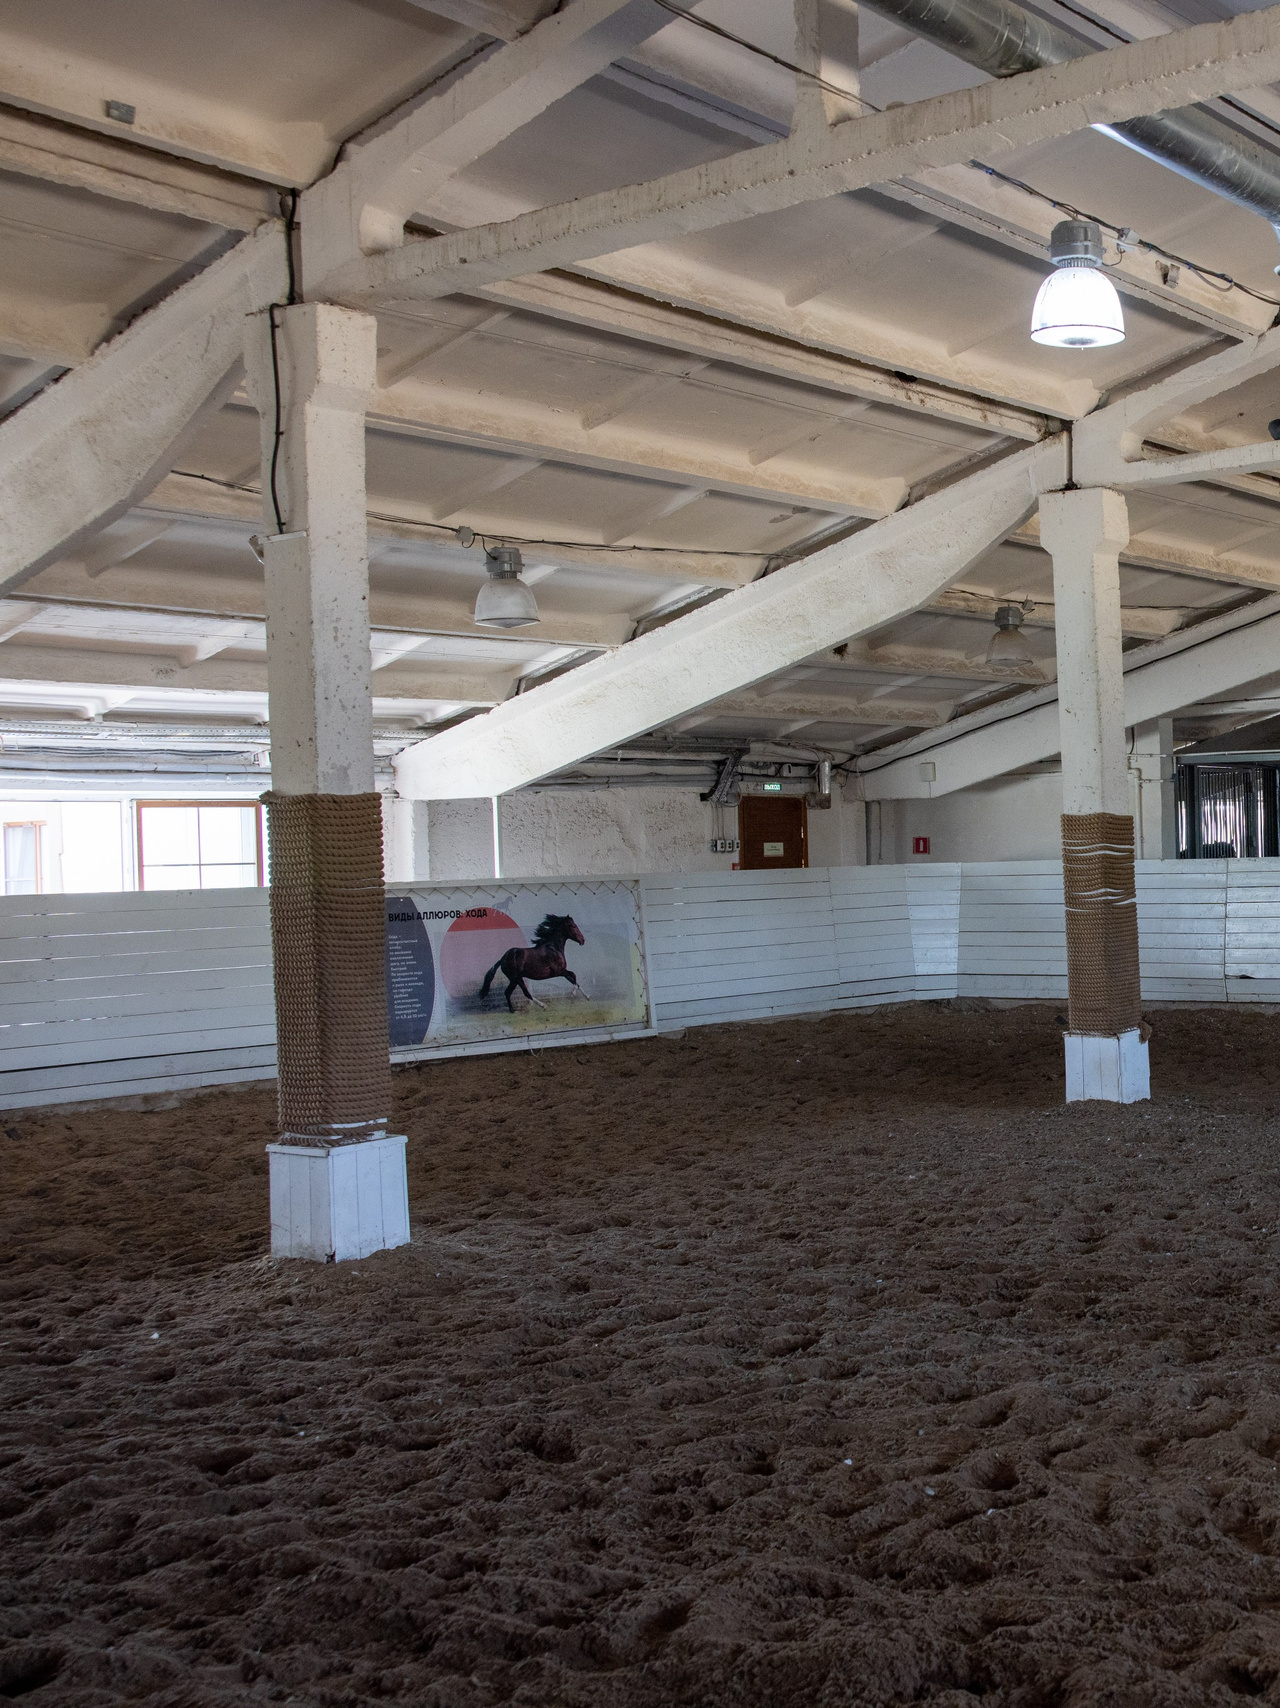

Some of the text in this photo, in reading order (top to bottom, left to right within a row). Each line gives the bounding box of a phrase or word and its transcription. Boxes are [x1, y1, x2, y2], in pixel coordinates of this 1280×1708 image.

[388, 908, 488, 923] ВИДЫ АЛЛЮРОВ: ХОДА
